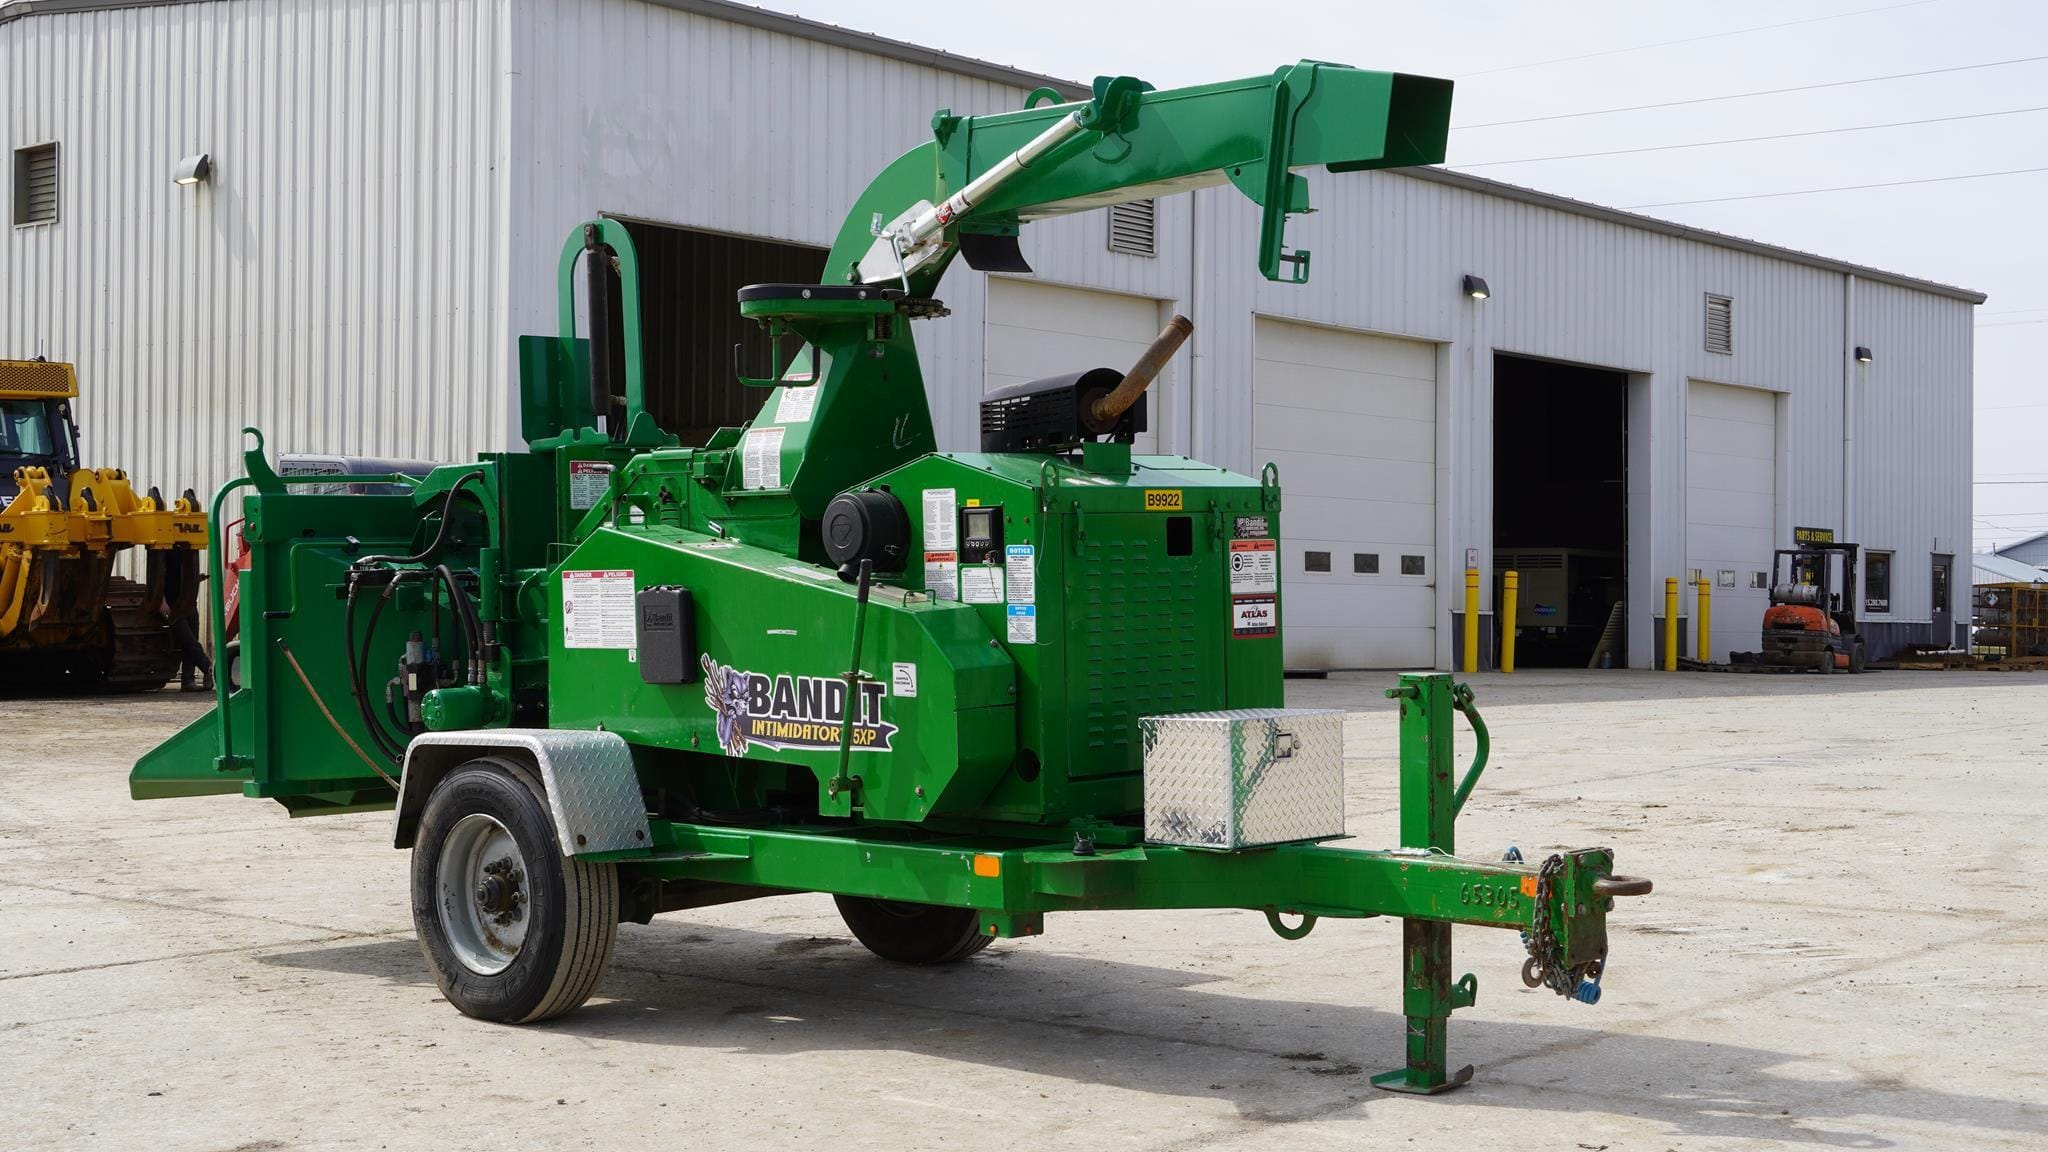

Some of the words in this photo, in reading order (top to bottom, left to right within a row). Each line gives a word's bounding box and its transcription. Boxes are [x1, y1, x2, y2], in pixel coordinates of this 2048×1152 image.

[1148, 494, 1180, 507] B9922
[1245, 518, 1265, 527] Bandit
[1797, 531, 1810, 541] PARTS
[1815, 532, 1832, 542] SERVICE
[1241, 610, 1268, 619] ATLAS
[749, 675, 886, 726] BANDIT
[752, 720, 840, 743] INTIMIDATOR
[848, 726, 877, 745] 5XP
